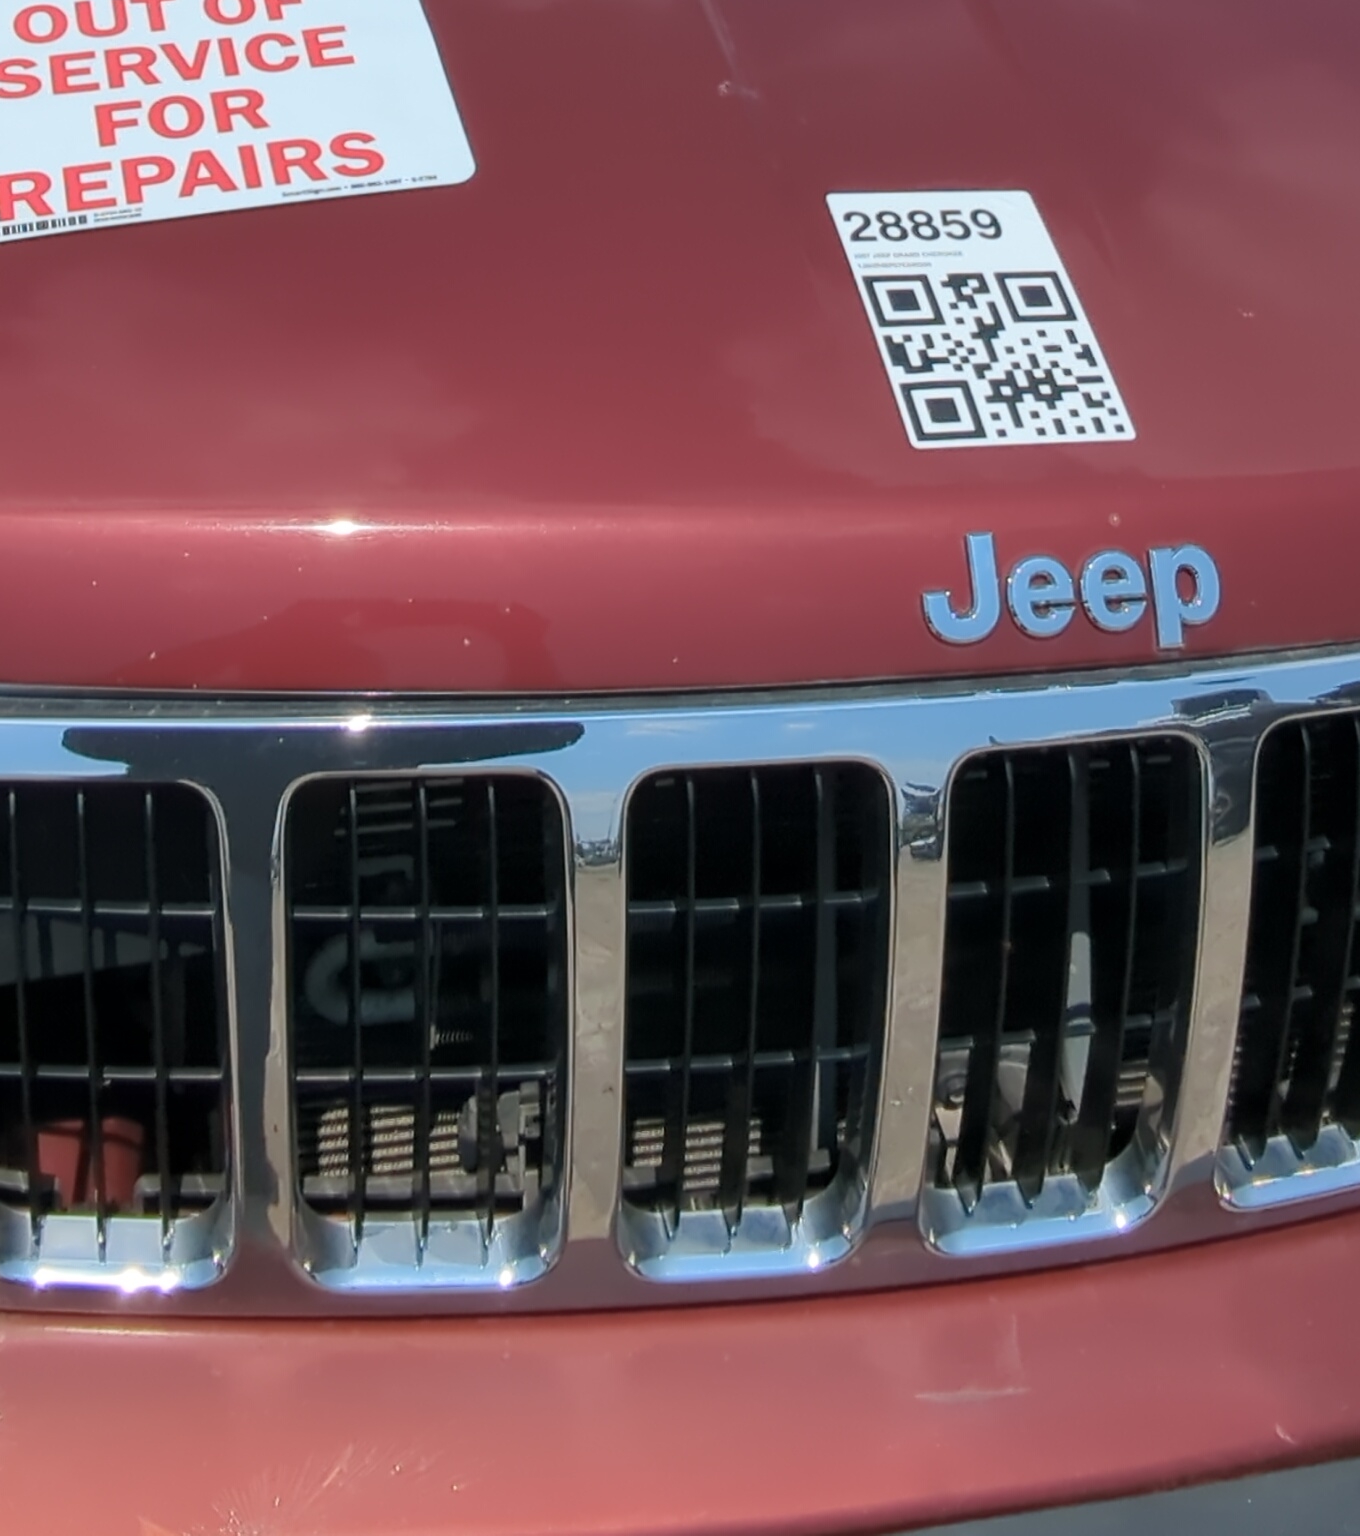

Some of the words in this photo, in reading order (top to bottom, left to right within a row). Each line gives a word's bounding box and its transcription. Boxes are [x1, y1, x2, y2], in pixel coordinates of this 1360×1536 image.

[93, 88, 270, 147] FOR
[842, 208, 1003, 242] 28859
[921, 531, 1222, 649] Jeep
